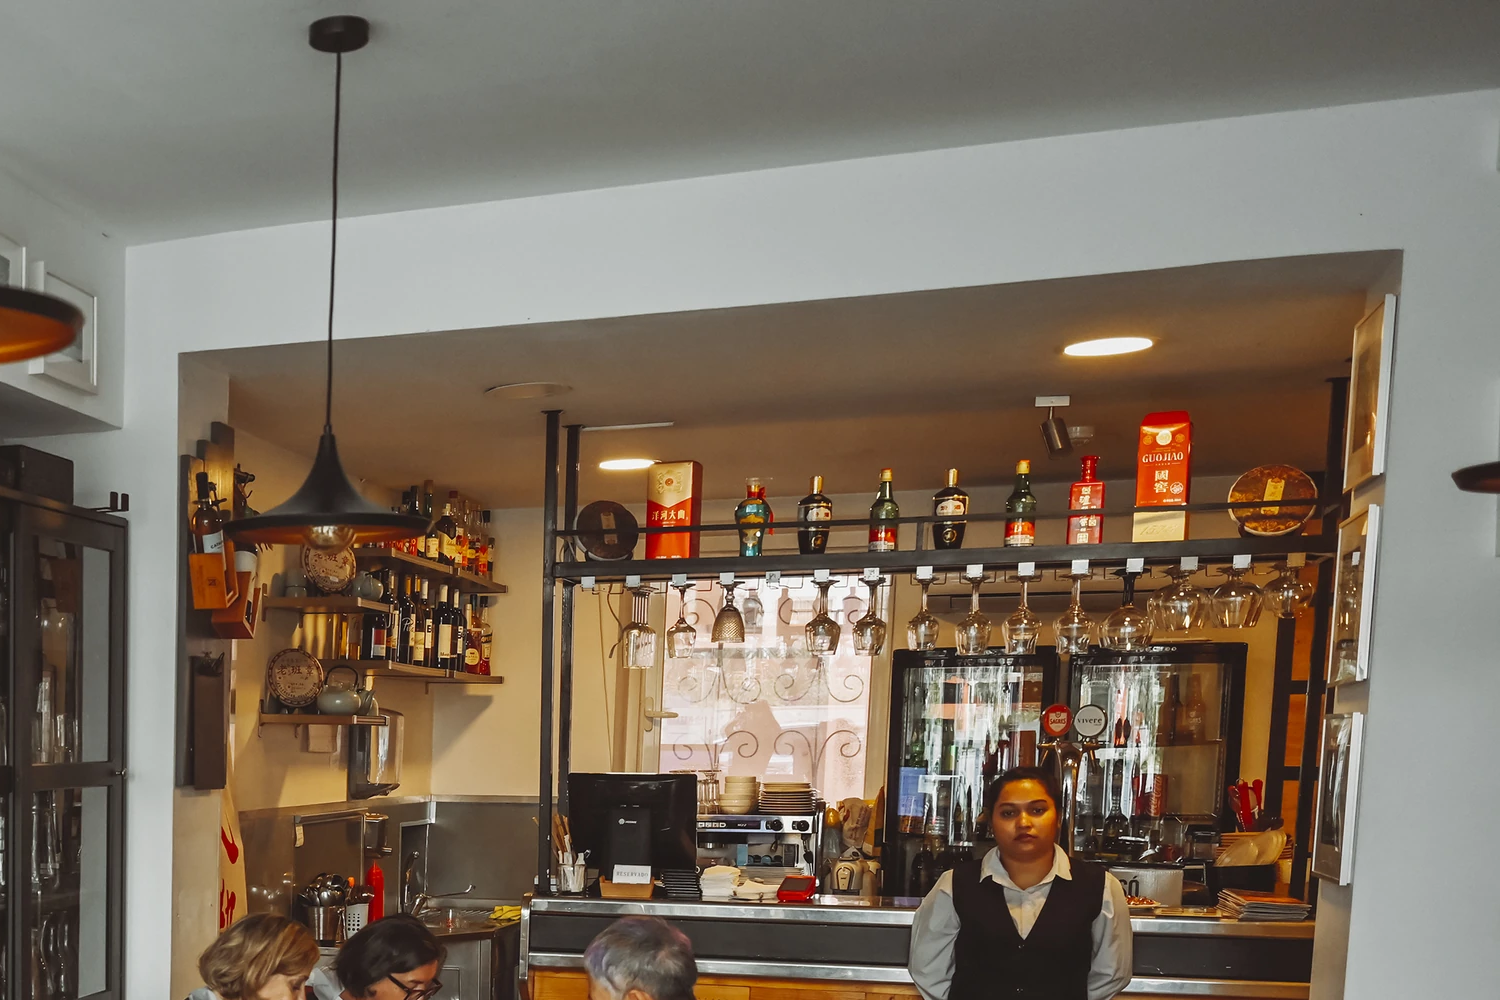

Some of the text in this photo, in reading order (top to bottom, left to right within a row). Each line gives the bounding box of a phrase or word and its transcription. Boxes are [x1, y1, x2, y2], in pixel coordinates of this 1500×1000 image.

[1142, 451, 1184, 463] GUOJIAO
[1049, 717, 1067, 725] SAGRES
[616, 870, 649, 878] RESERVADO
